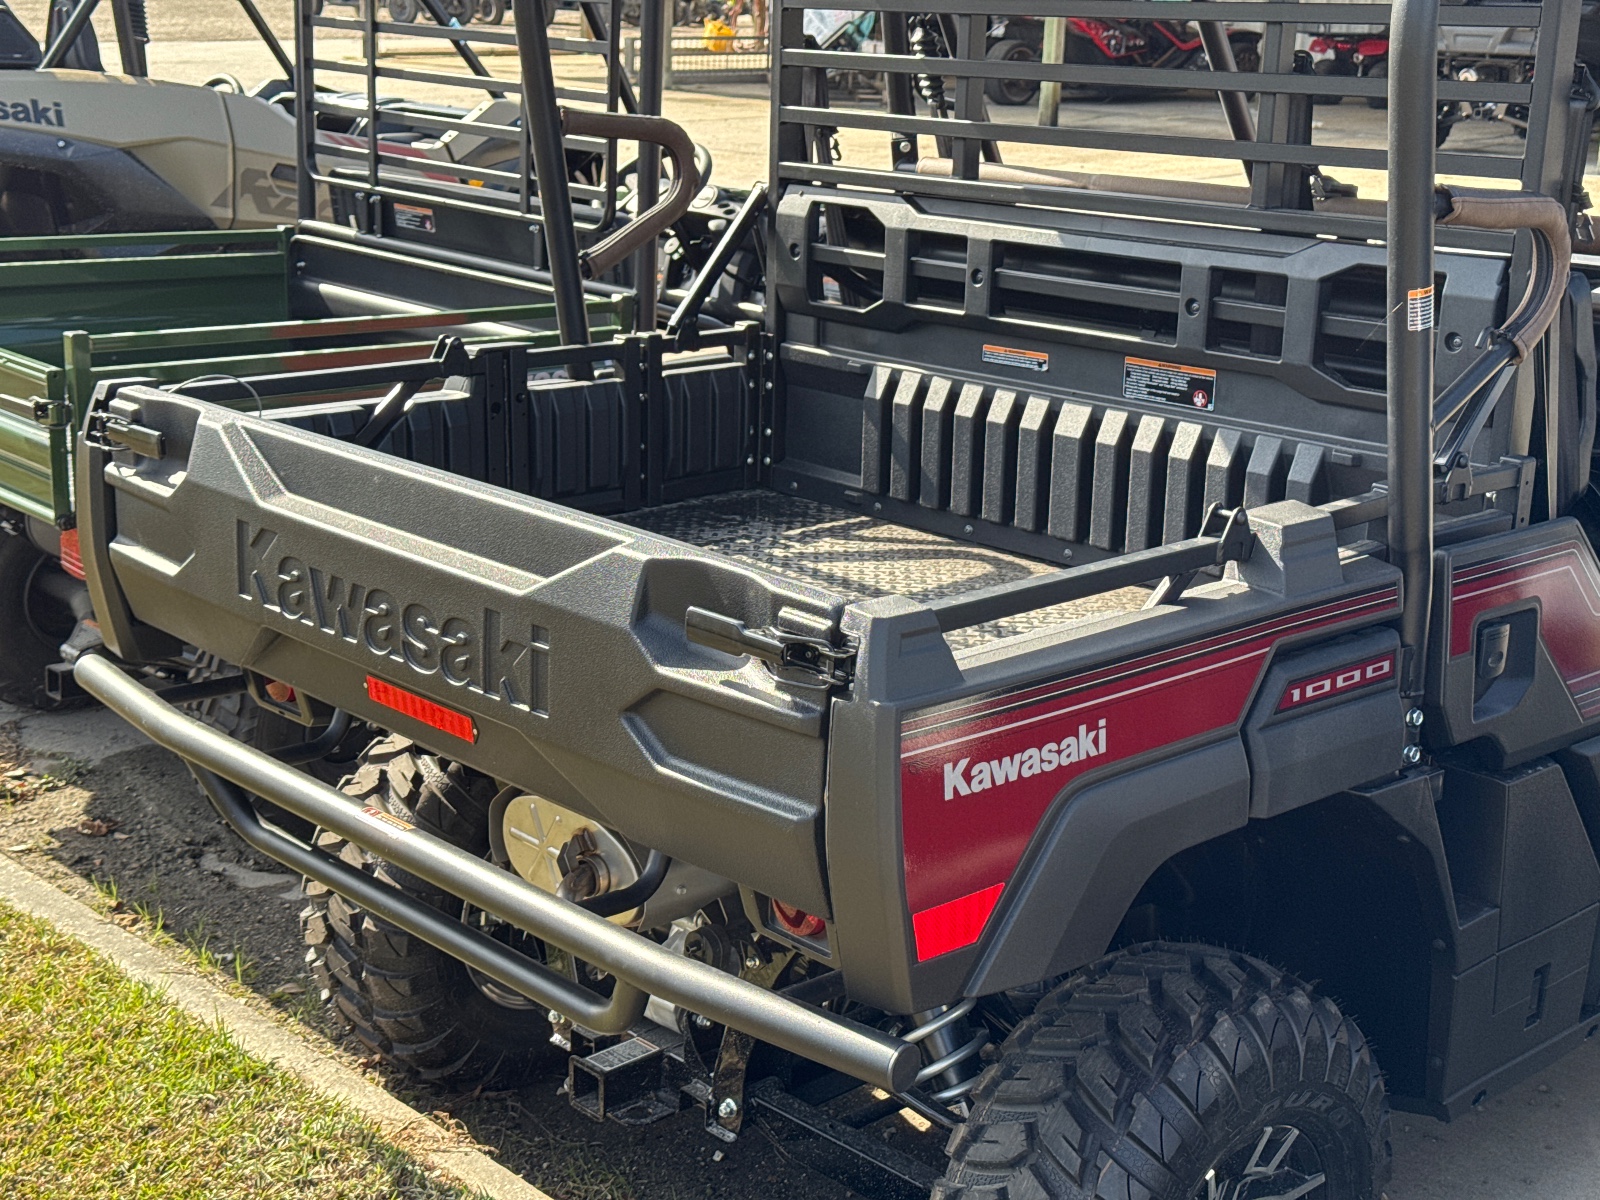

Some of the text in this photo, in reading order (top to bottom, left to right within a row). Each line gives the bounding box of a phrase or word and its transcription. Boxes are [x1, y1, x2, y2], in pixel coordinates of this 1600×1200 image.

[236, 518, 550, 719] Kawasaki
[1291, 660, 1390, 703] 1000
[943, 717, 1107, 801] Kawasaki
